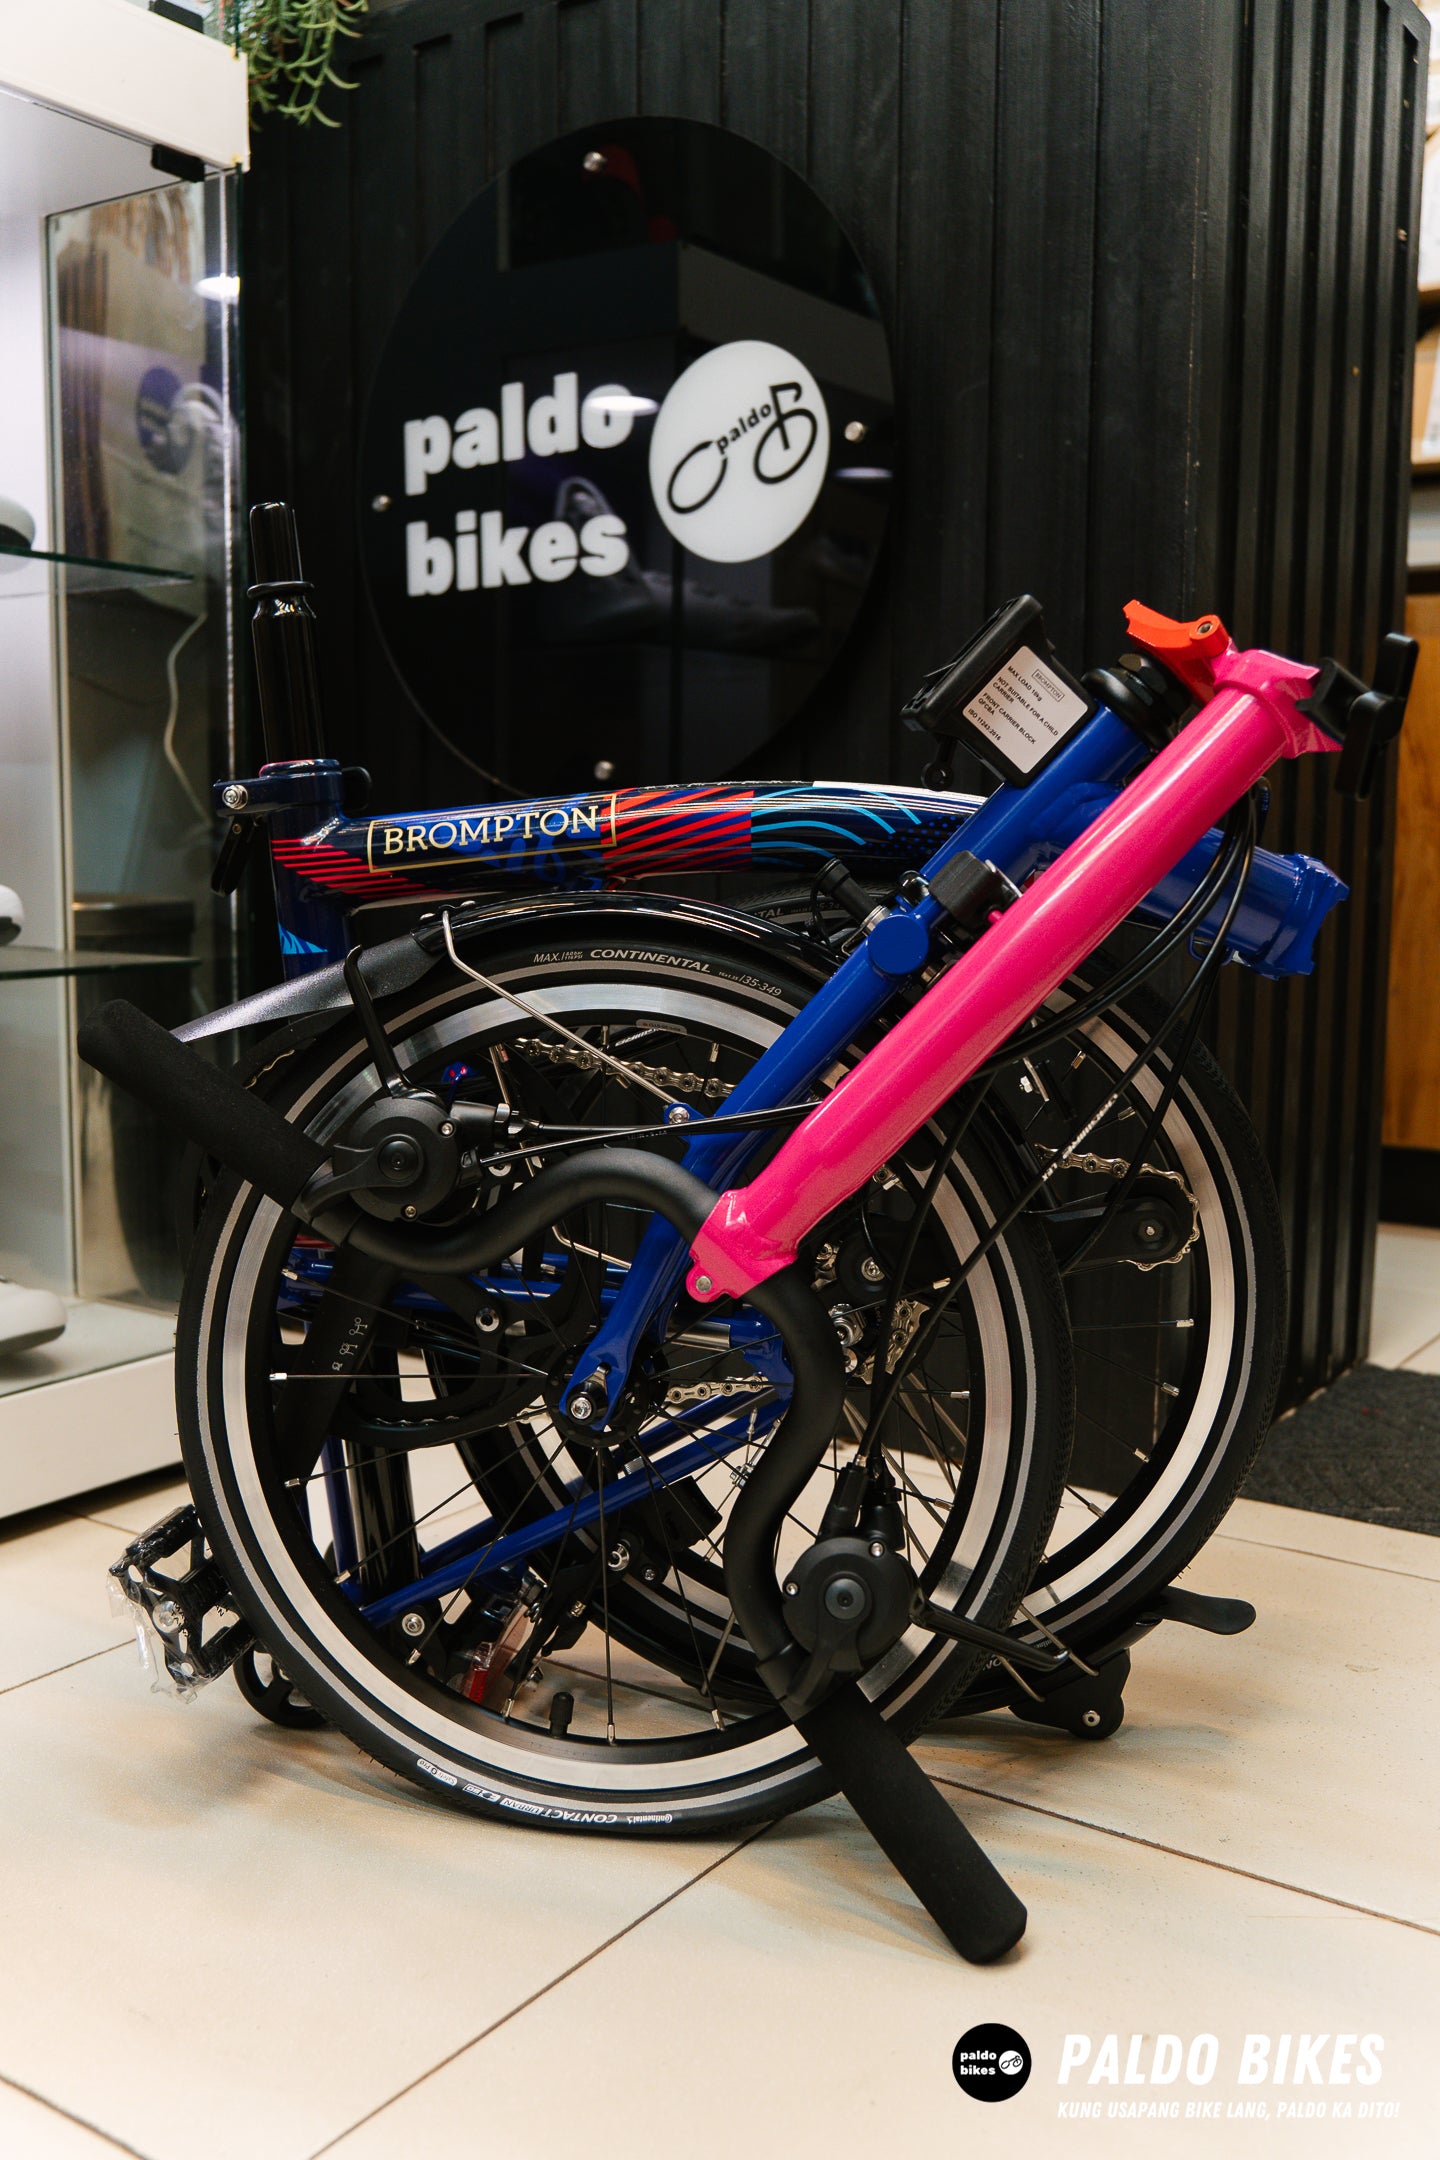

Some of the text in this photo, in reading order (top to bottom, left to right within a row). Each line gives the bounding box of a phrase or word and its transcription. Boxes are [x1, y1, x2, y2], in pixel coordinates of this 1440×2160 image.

[404, 372, 634, 496] paldo
[715, 404, 771, 454] paldo
[406, 510, 629, 597] bikes
[1007, 666, 1019, 678] MAX
[1017, 676, 1033, 691] LOAD
[1034, 672, 1062, 699] BROMPTON
[992, 682, 1015, 704] CARRIER
[997, 677, 1009, 688] NOT
[1007, 686, 1031, 710] SUITABLE
[1029, 707, 1041, 719] FOR
[1043, 721, 1059, 736] CHILD
[968, 708, 978, 719] ISO
[982, 692, 1036, 745] FRONT CARRIER BLOCK
[383, 805, 598, 855] BROMPTON
[590, 949, 711, 973] CONTINENTAL
[504, 1800, 541, 1814] URBAN
[542, 1810, 617, 1823] CONTACT
